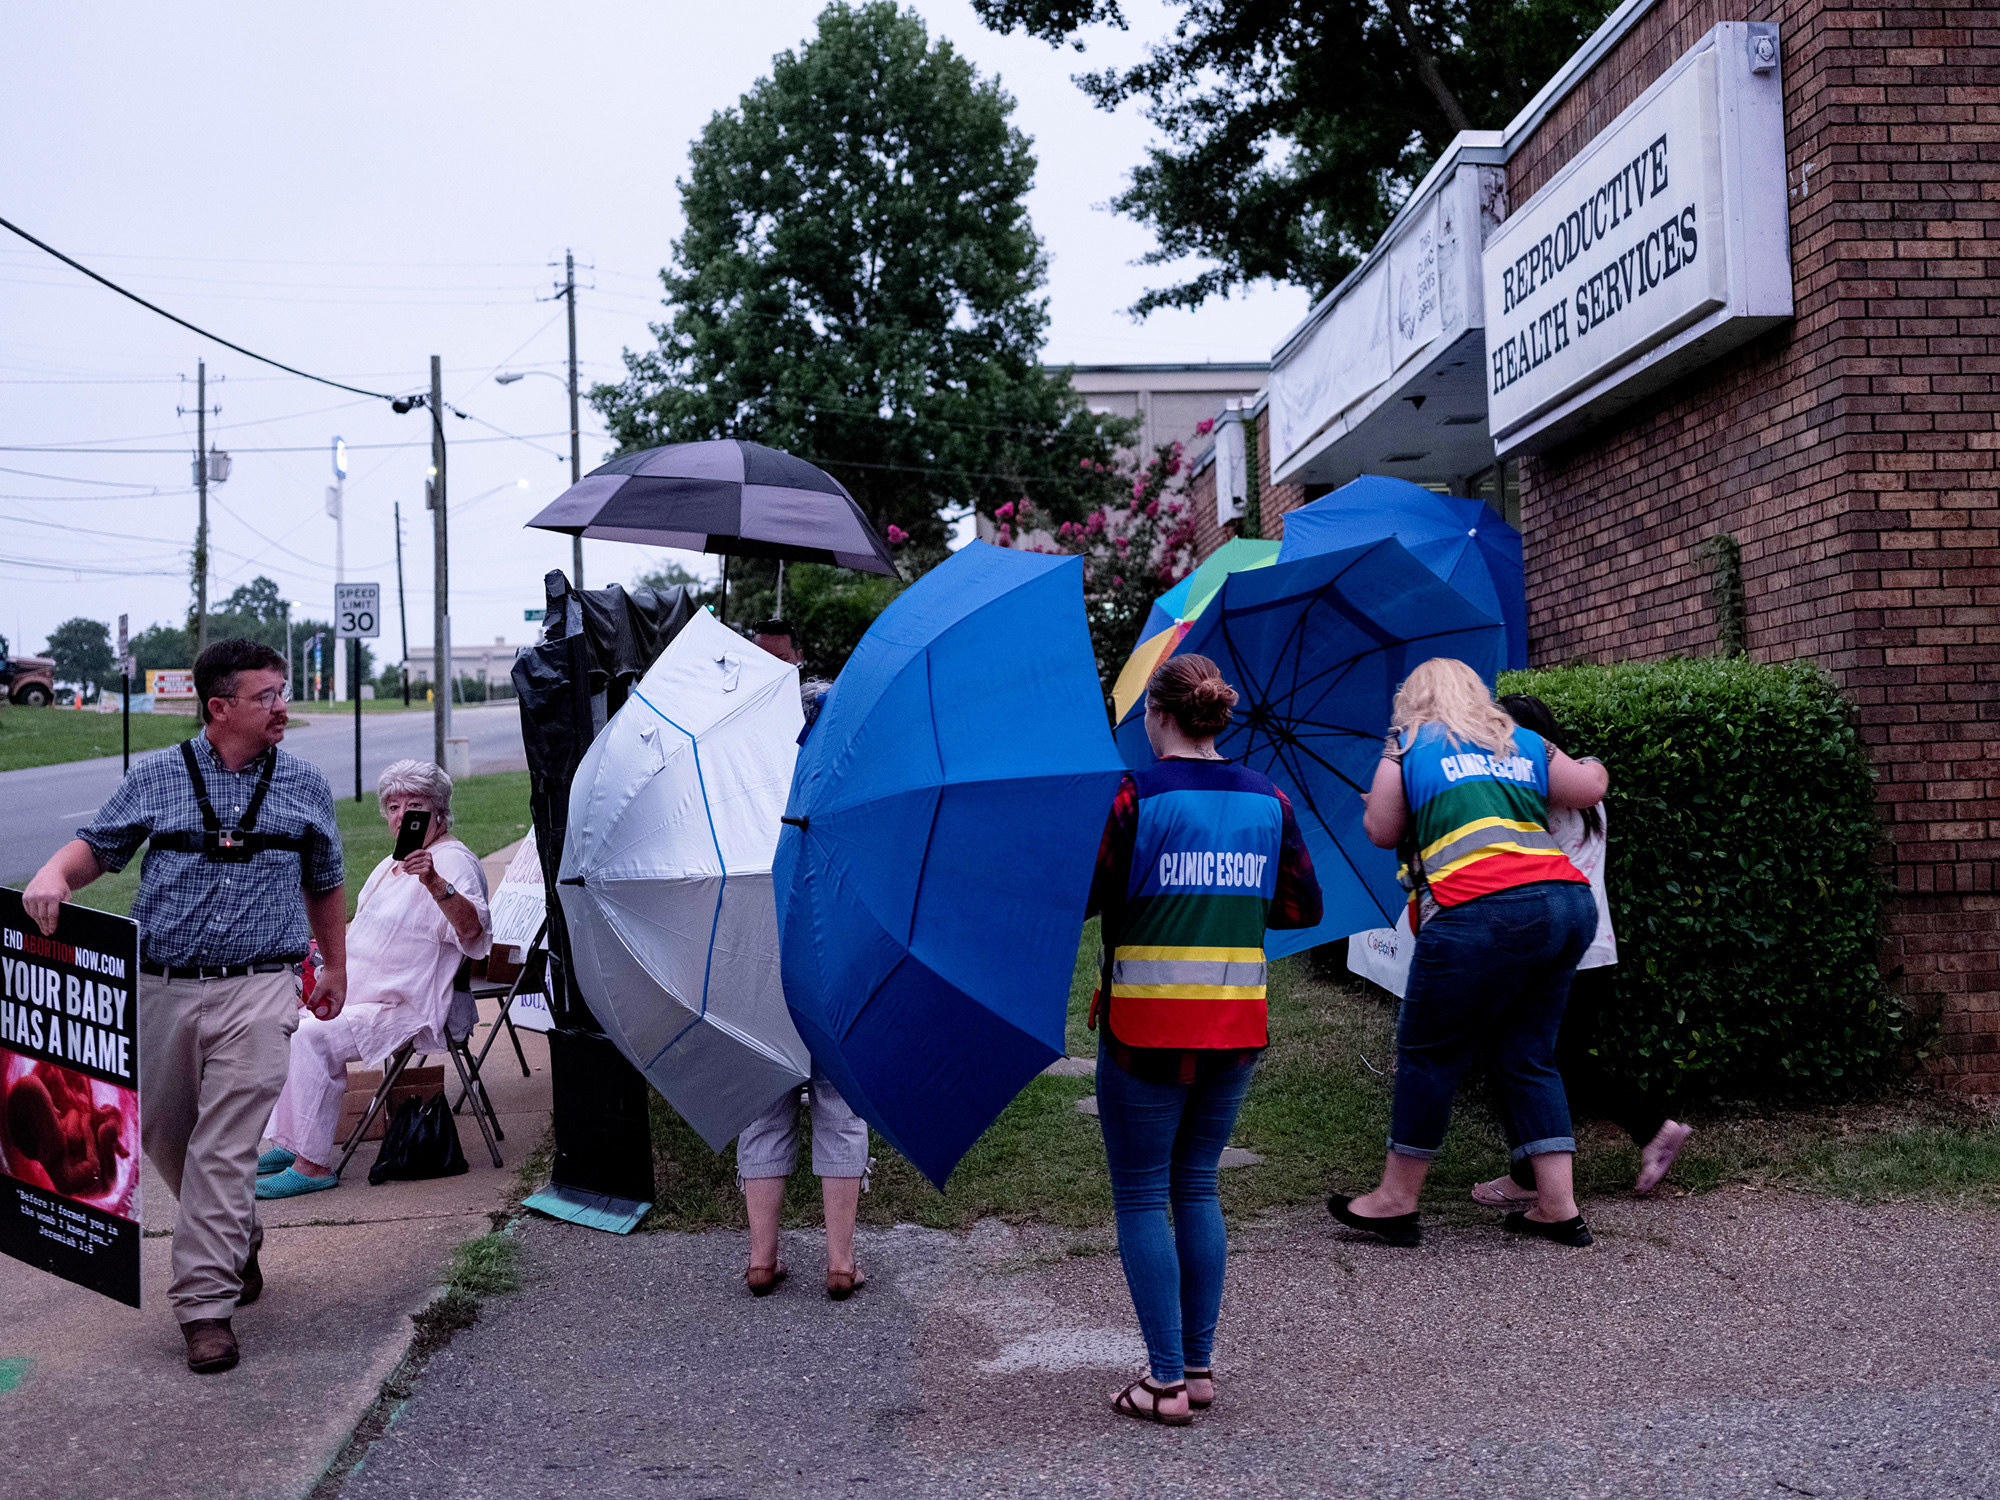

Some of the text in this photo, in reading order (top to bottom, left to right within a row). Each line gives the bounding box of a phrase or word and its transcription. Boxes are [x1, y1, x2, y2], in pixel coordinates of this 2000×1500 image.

[1502, 132, 1669, 316] REPRODUCTIVE
[1491, 202, 1698, 396] HEALTH SERVICES
[338, 589, 376, 599] SPEED
[342, 600, 372, 610] LIMIT
[342, 612, 374, 632] 30
[1440, 753, 1490, 782] CLINIC
[1159, 851, 1215, 887] CLINIC
[3, 927, 125, 979] ENDABORTIONNOW.COM
[1, 956, 127, 1030] YOUR BABY
[0, 1000, 130, 1078] HAS A NAME
[20, 1204, 35, 1217] the
[36, 1212, 56, 1225] womb
[59, 1219, 64, 1229] I
[66, 1221, 87, 1237] knew
[50, 1202, 55, 1211] I
[58, 1205, 86, 1223] formed
[89, 1218, 106, 1231] you
[107, 1223, 119, 1236] in
[39, 1225, 94, 1254] Jeremiah 1:5
